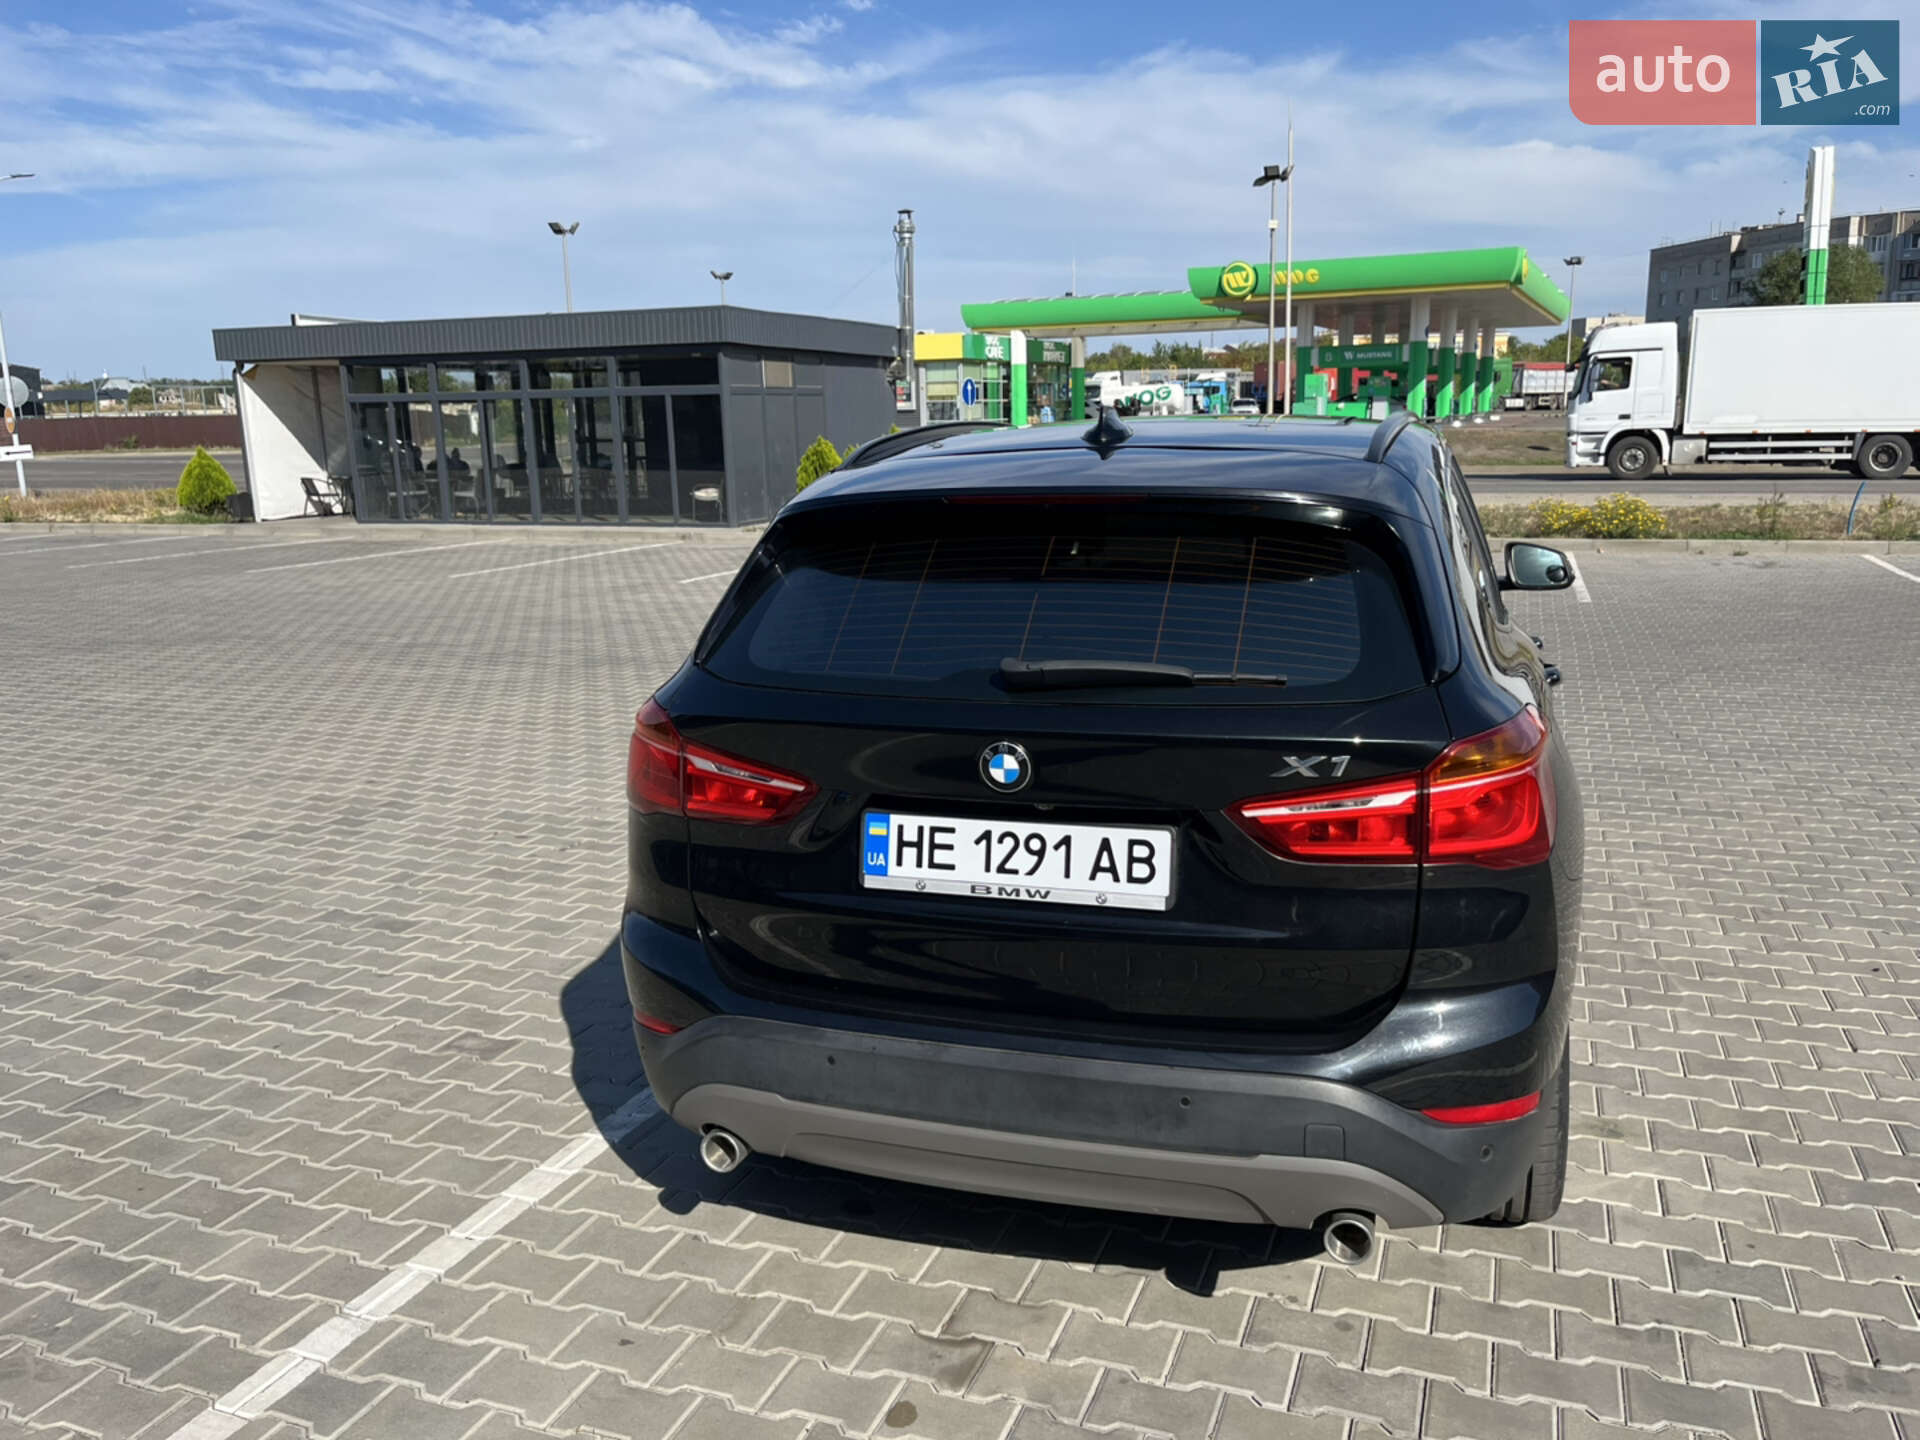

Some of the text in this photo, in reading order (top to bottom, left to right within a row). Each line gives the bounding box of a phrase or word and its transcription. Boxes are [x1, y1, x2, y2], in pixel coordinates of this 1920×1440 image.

[984, 743, 1025, 761] BMW
[1268, 755, 1352, 778] X1
[867, 851, 887, 867] UA
[895, 824, 1157, 885] HE 1291 AB
[970, 884, 1051, 900] BMW
